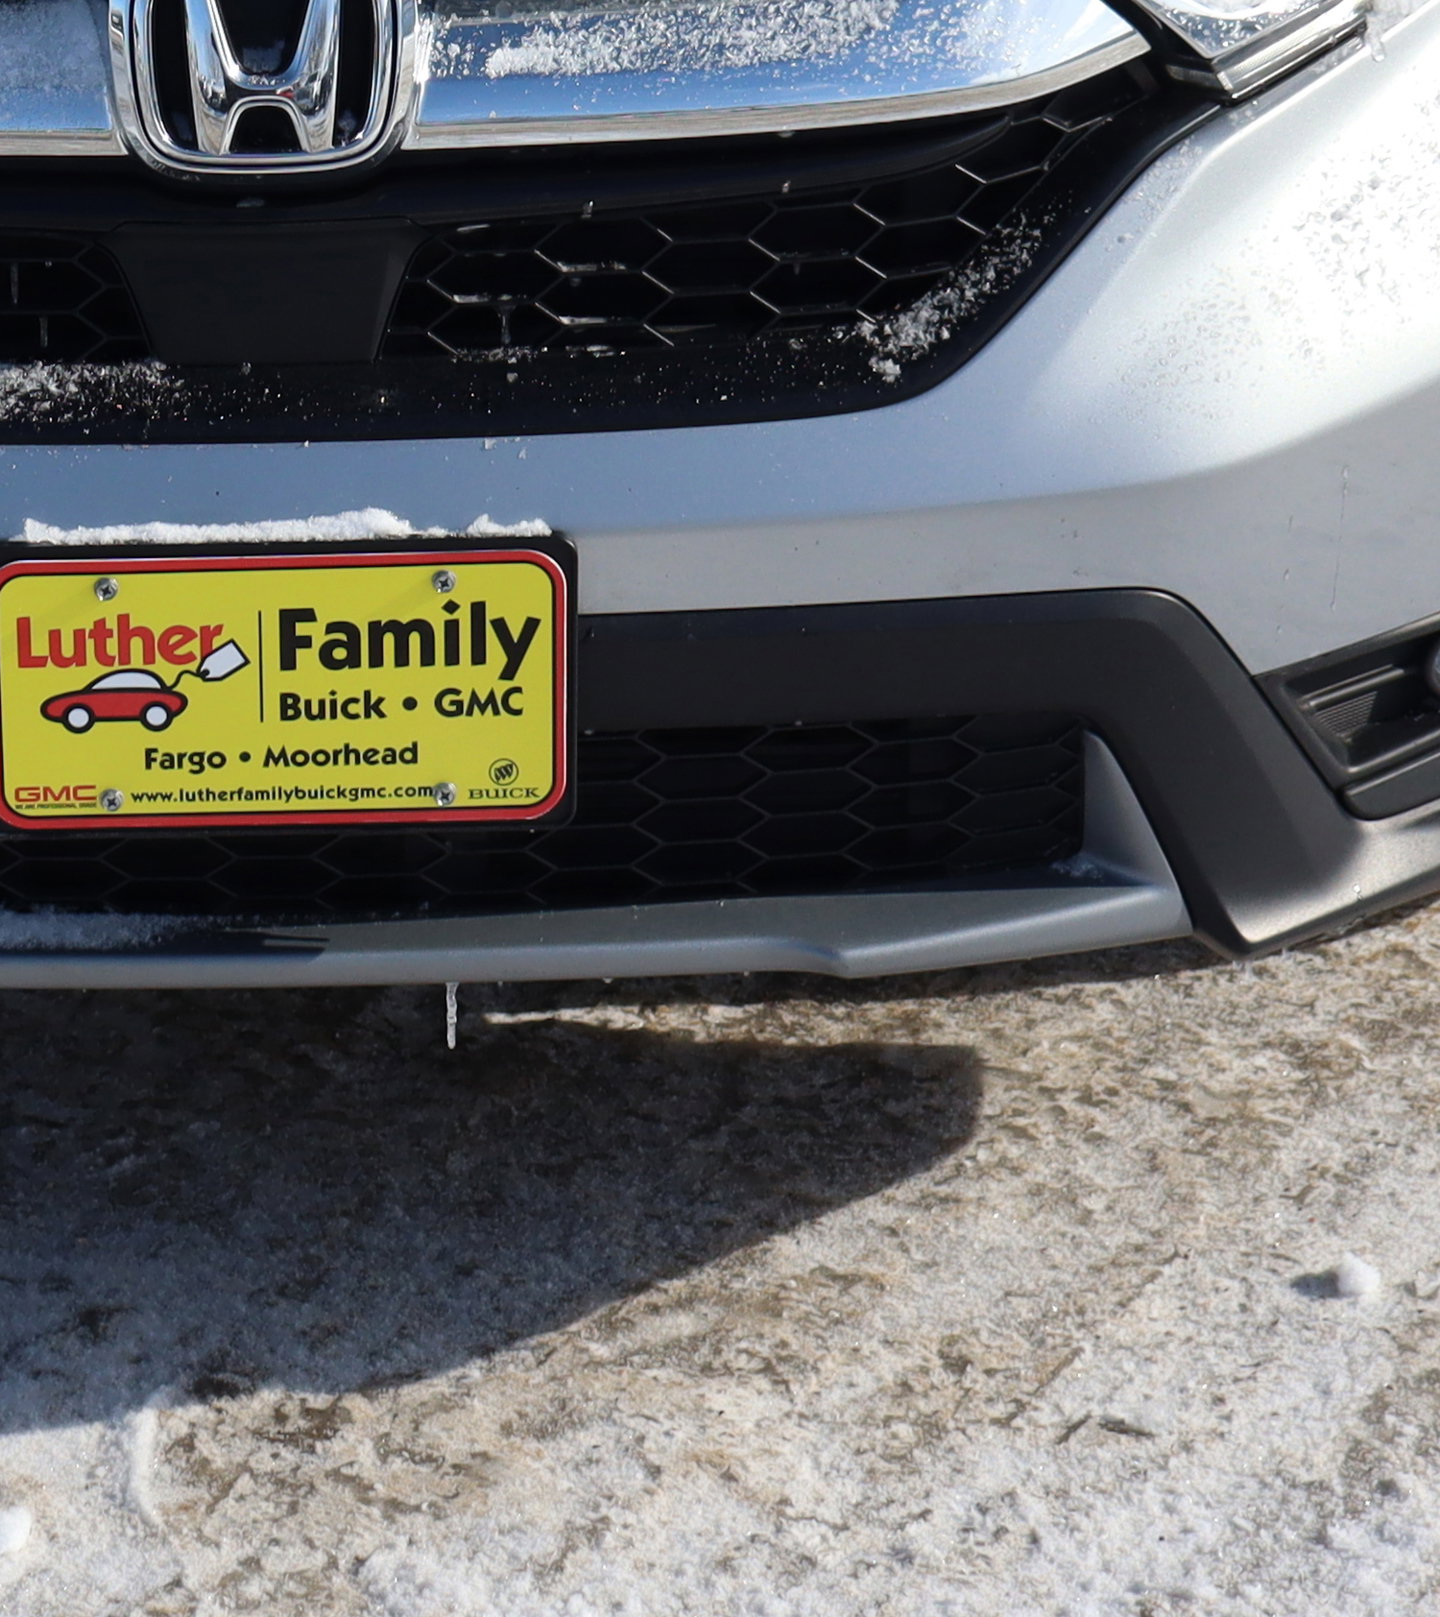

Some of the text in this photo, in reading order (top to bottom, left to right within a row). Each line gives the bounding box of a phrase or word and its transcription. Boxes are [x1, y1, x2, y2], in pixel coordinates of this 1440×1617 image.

[16, 600, 542, 681] Luther Family
[279, 686, 525, 722] Buick GMC
[144, 741, 419, 775] Fargo Moorhead
[14, 782, 541, 806] GMC www.lutherfamilybuickgmc.com BUICK
